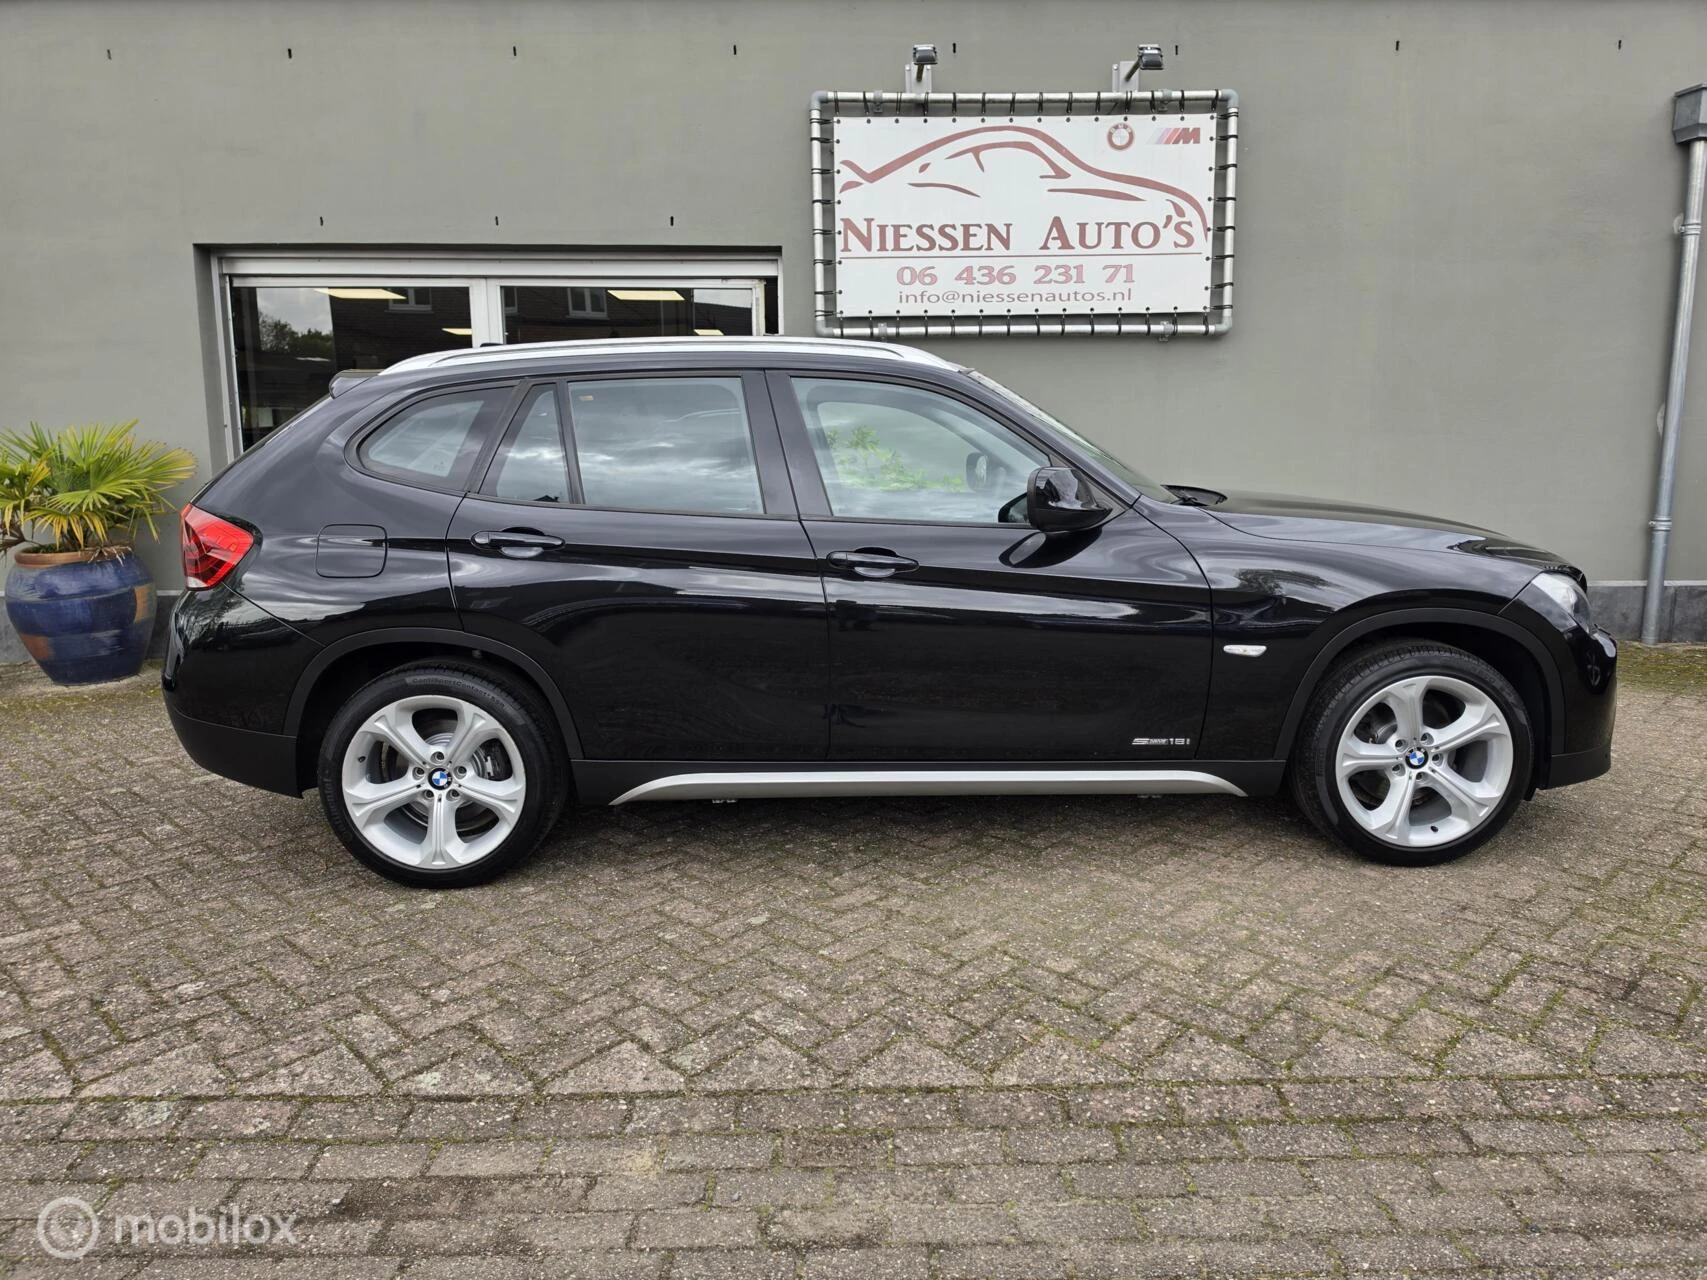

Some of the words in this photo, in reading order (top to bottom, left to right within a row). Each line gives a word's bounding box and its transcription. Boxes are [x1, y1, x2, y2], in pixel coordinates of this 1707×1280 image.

[840, 217, 1013, 252] NIESSEN
[1039, 215, 1195, 250] AUTO'S
[896, 265, 938, 286] 06
[954, 265, 1017, 286] 436
[1033, 264, 1086, 285] 231
[1102, 263, 1136, 284] 71
[898, 288, 1132, 304] info@niessenautos.nl
